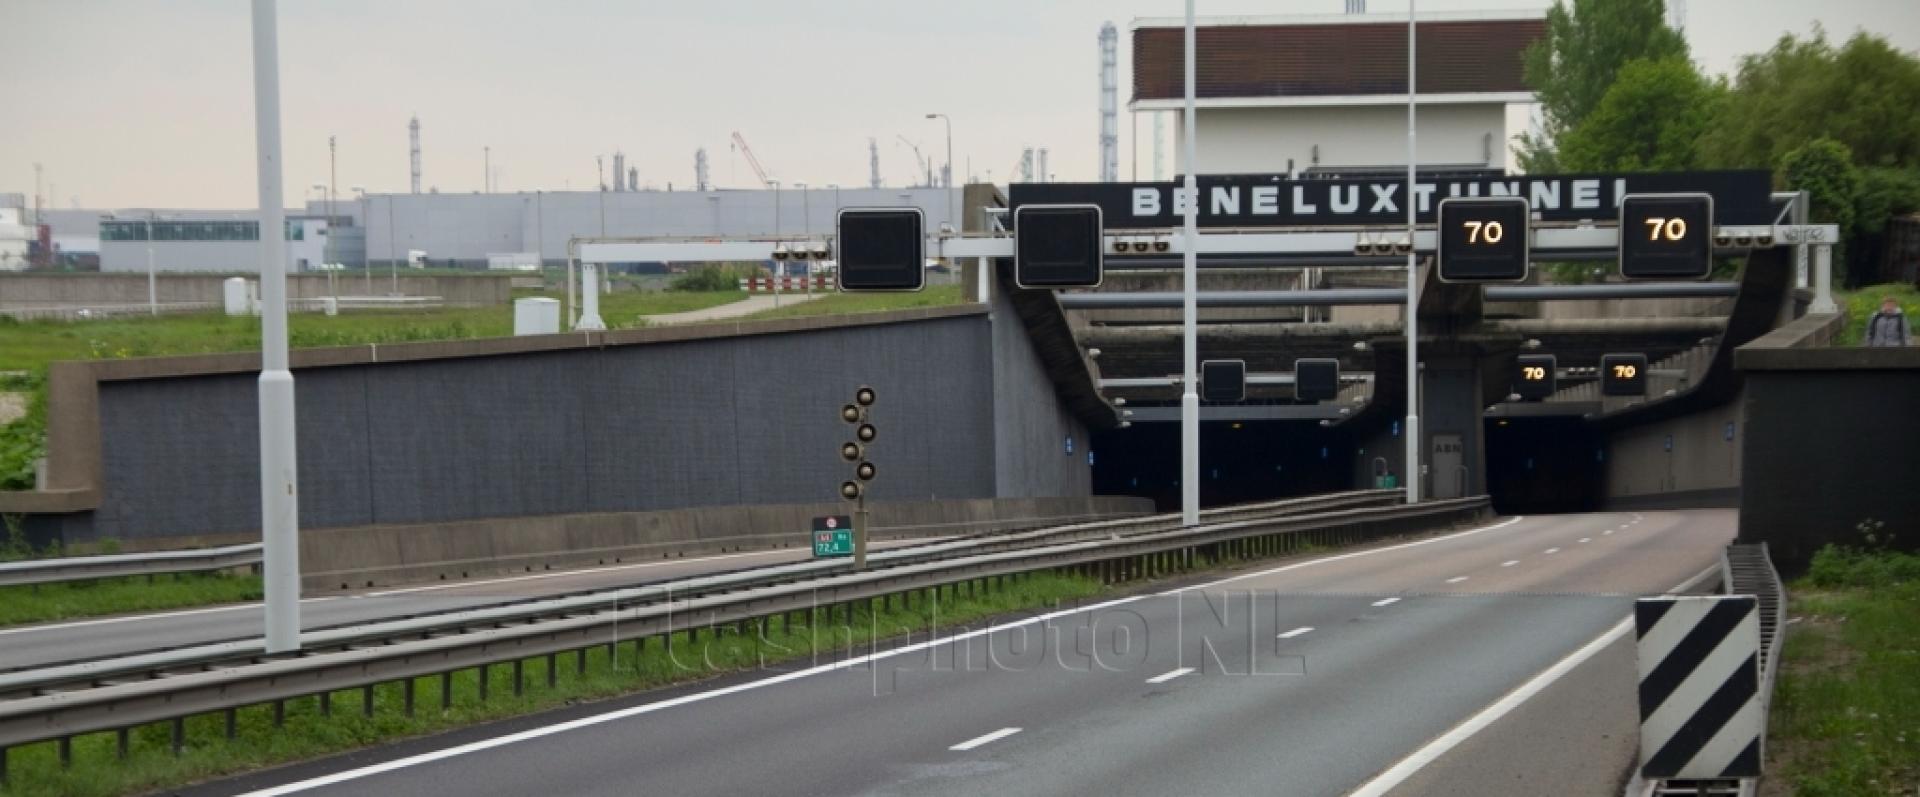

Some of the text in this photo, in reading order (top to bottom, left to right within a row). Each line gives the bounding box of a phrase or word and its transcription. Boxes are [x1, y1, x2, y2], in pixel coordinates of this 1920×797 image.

[1463, 221, 1503, 243] 70
[1645, 217, 1687, 241] 70
[1523, 367, 1544, 380] 70
[1613, 365, 1636, 378] 70
